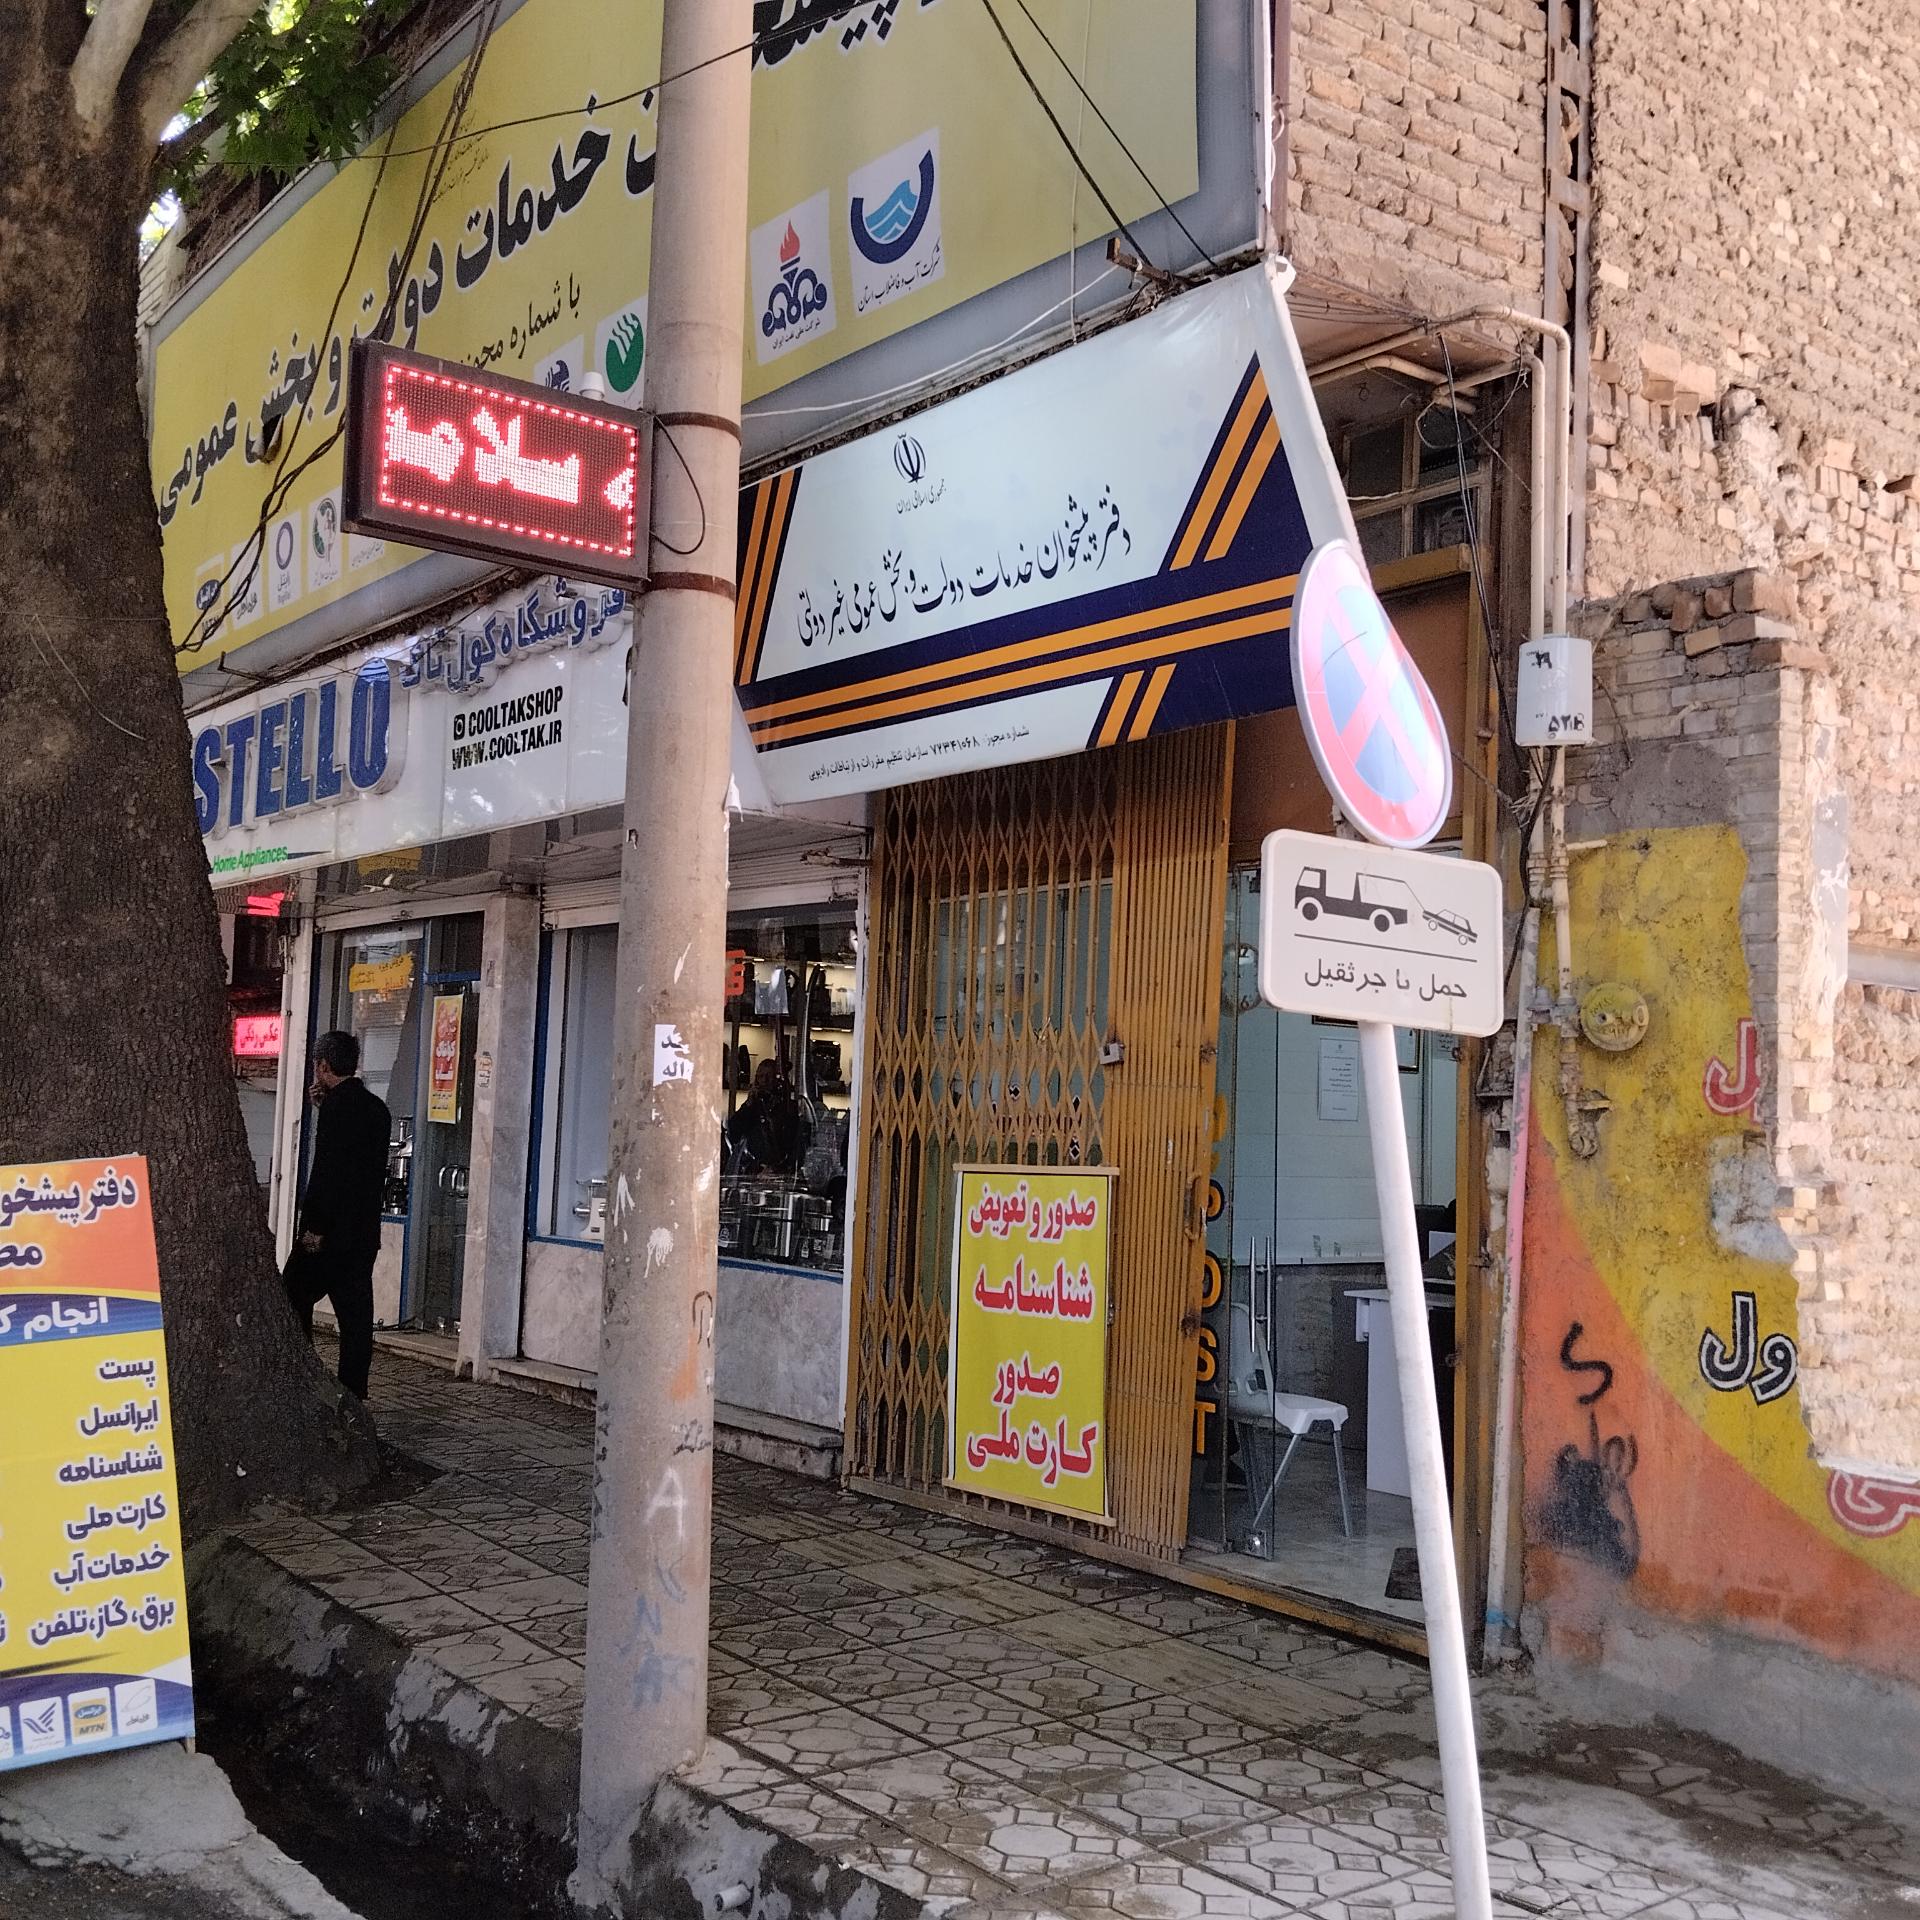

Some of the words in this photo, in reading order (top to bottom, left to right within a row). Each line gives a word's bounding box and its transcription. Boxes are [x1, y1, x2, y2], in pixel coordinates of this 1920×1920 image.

[456, 94, 612, 289] خدمات
[509, 279, 563, 360] شماره
[569, 271, 581, 319] با
[160, 401, 238, 527] عمومی
[1036, 494, 1099, 580] پیشخوان
[1096, 483, 1132, 572] دفتر
[878, 548, 910, 623] بخش
[912, 555, 965, 614] دولت
[968, 542, 1034, 598] خدمات
[500, 577, 625, 651] فروشگاه
[797, 589, 827, 648] دولتی
[827, 579, 845, 647] غیر
[847, 580, 878, 634] عمومی
[446, 614, 498, 693] کول
[467, 685, 564, 738] COOLTAKSHOP
[1006, 726, 1030, 742] شماره
[451, 719, 563, 771] WWW.COOLTAK.IR
[212, 853, 237, 873] Home
[238, 845, 289, 872] Appliances
[1418, 973, 1467, 1002] حمل
[83, 1168, 137, 1222] دفتر
[970, 1183, 1027, 1236] تعویض
[1029, 1201, 1041, 1238] و
[1042, 1193, 1097, 1240] صدور
[974, 1258, 1093, 1319] شناسنامه
[24, 1296, 109, 1340] انجام
[99, 1360, 156, 1388] پست
[993, 1355, 1060, 1405] صدور
[80, 1399, 159, 1436] ایرانسل
[967, 1409, 1020, 1468] ملی
[59, 1444, 163, 1483] شناسنامه
[1025, 1419, 1097, 1485] کارت
[66, 1506, 114, 1541] ملی
[116, 1494, 167, 1531] کارت
[54, 1552, 85, 1592] آب
[87, 1543, 170, 1578] خدمات
[79, 1722, 105, 1735] MTN
